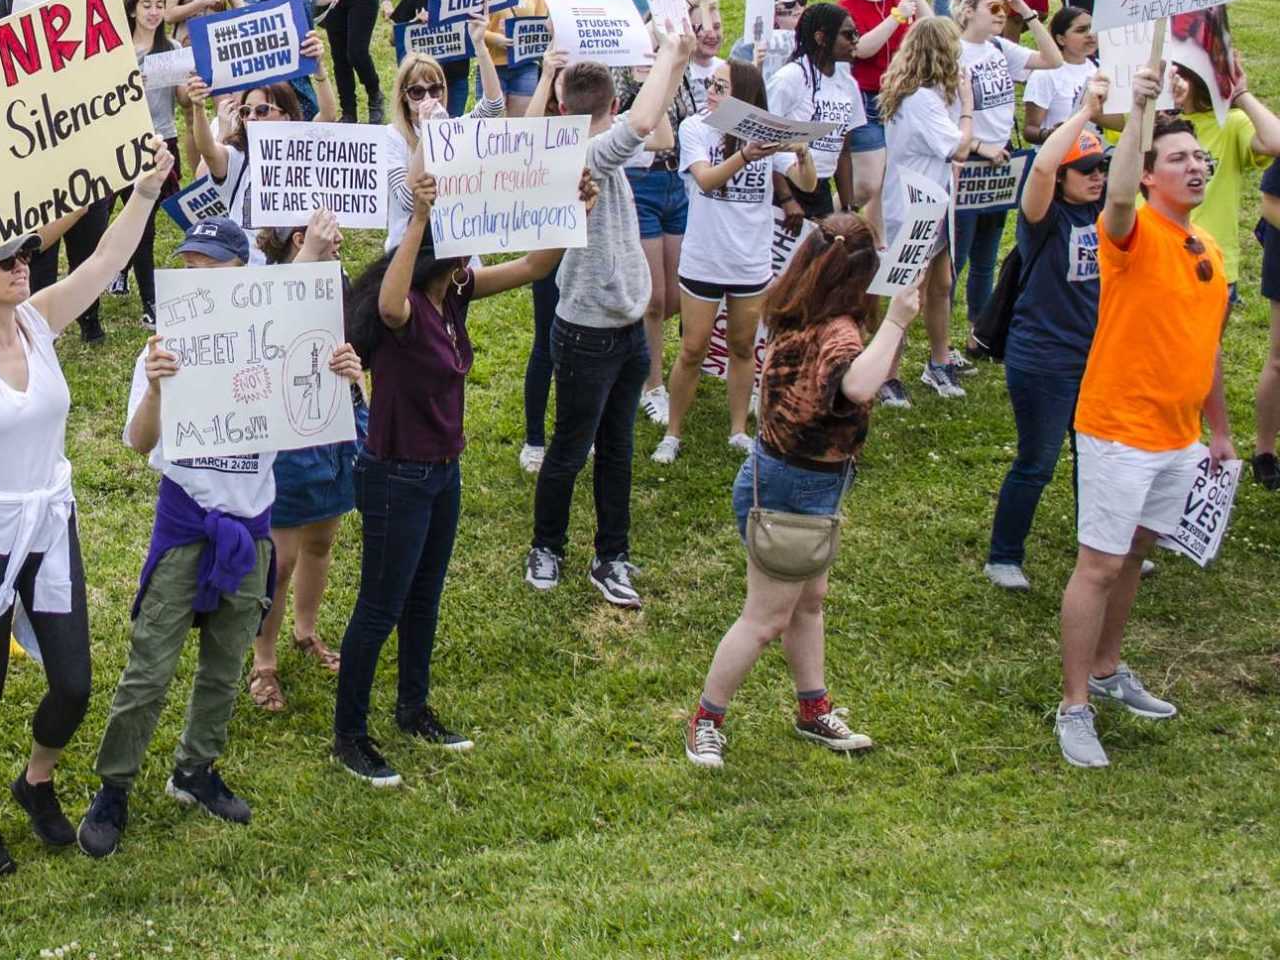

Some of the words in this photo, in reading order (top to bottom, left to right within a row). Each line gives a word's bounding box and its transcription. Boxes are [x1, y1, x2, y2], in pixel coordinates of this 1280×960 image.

[238, 14, 286, 38] LIVES
[576, 19, 630, 28] STUDENTS
[578, 29, 623, 38] DEMAND
[255, 31, 290, 54] FOR
[411, 35, 434, 47] FOR
[436, 33, 460, 45] OUR
[518, 34, 540, 44] FOR
[580, 40, 619, 48] ACTION
[217, 40, 254, 62] OUR
[231, 49, 291, 77] MARCH
[6, 69, 144, 160] Silencers
[260, 139, 282, 161] WE
[286, 140, 313, 162] ARE
[317, 140, 377, 164] CHANGE
[426, 121, 464, 163] 18th
[476, 120, 534, 166] Century
[545, 119, 580, 150] Laws
[261, 165, 280, 187] WE
[285, 166, 312, 188] ARE
[315, 167, 377, 190] VICTIMS
[494, 161, 550, 192] regulate
[959, 165, 1011, 178] MARCH
[958, 179, 986, 192] FOR
[988, 176, 1016, 189] OUR
[260, 192, 278, 212] WE
[283, 193, 308, 212] ARE
[312, 193, 377, 214] STUDENTS
[956, 192, 994, 206] LIVES
[450, 202, 510, 248] Century
[512, 201, 577, 240] Weapons
[910, 220, 935, 240] WE
[898, 244, 925, 264] WE
[886, 267, 908, 285] WE
[160, 288, 216, 326] IT'S
[231, 281, 273, 309] GOT
[284, 281, 306, 301] TO
[315, 279, 335, 301] BE
[164, 332, 238, 368] SWEET
[239, 373, 262, 390] NOT
[195, 456, 229, 469] MARCH
